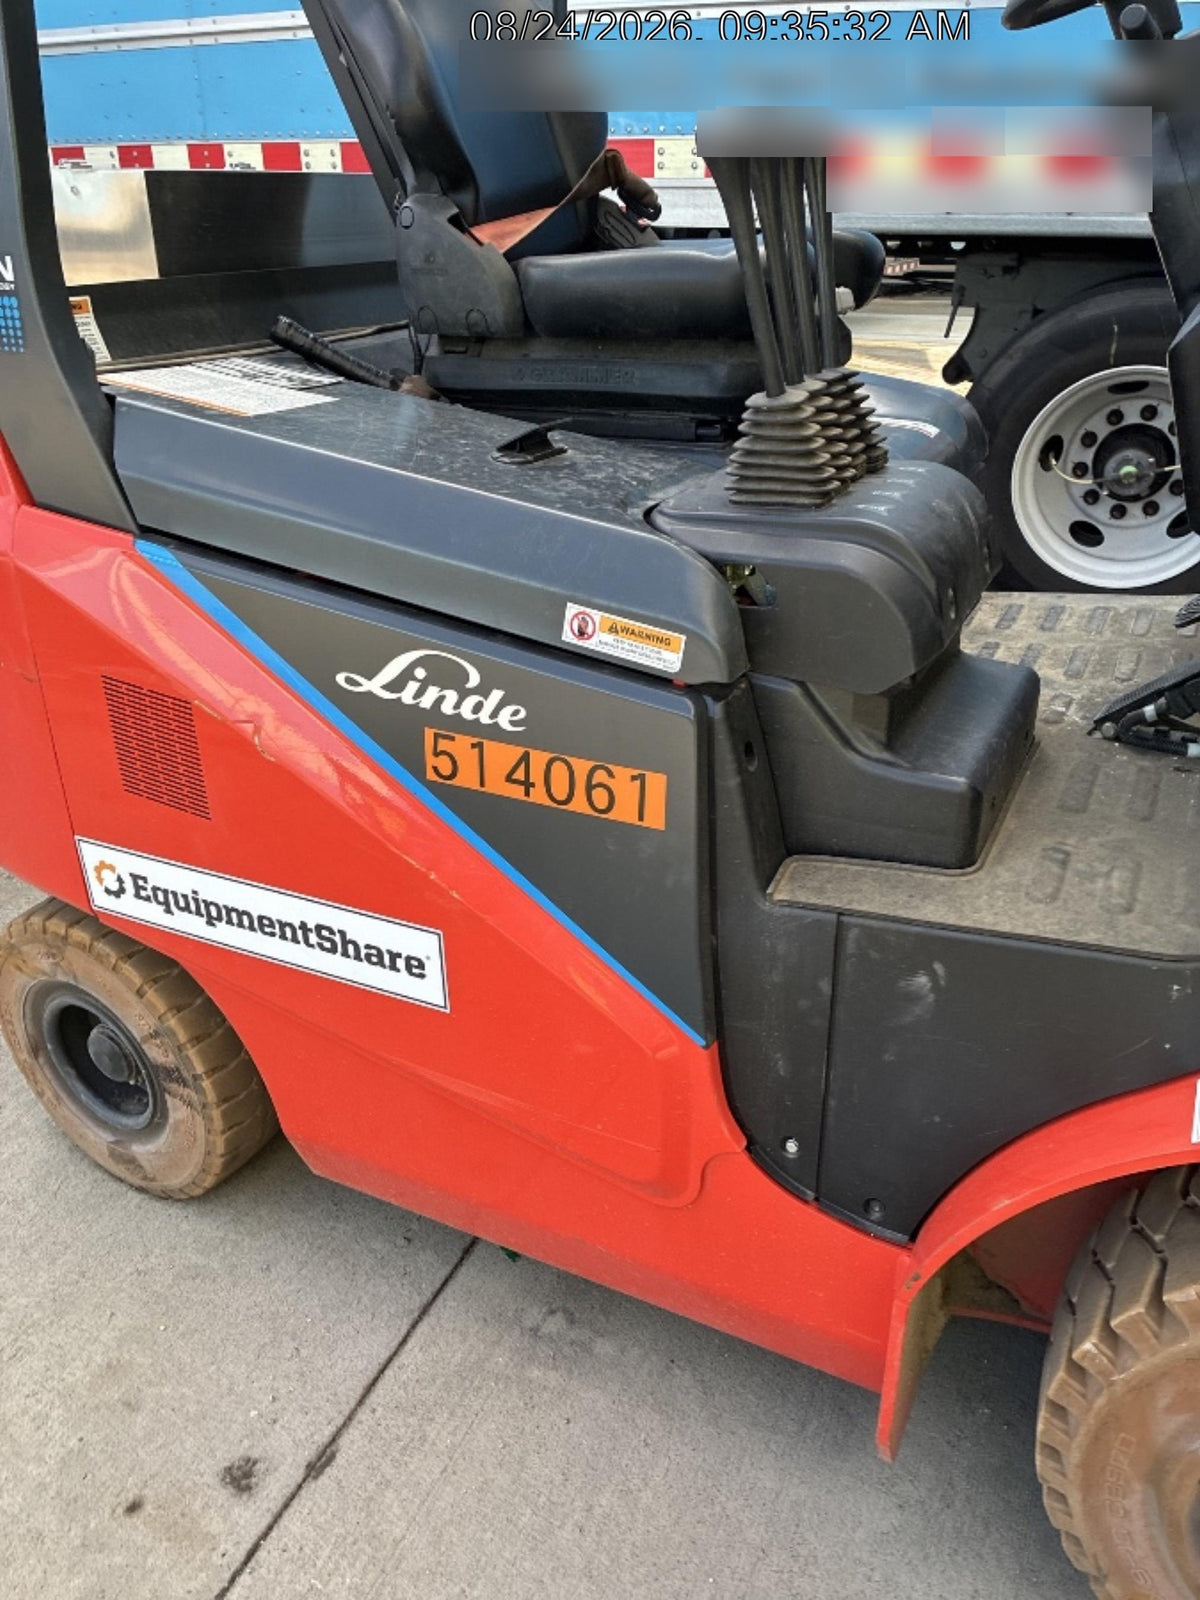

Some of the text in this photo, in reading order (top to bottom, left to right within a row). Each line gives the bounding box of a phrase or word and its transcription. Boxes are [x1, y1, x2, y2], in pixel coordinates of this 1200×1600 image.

[620, 625, 672, 647] WARNING
[335, 649, 527, 731] Linde
[431, 731, 648, 823] 514061
[128, 871, 427, 980] EquipmentShare
